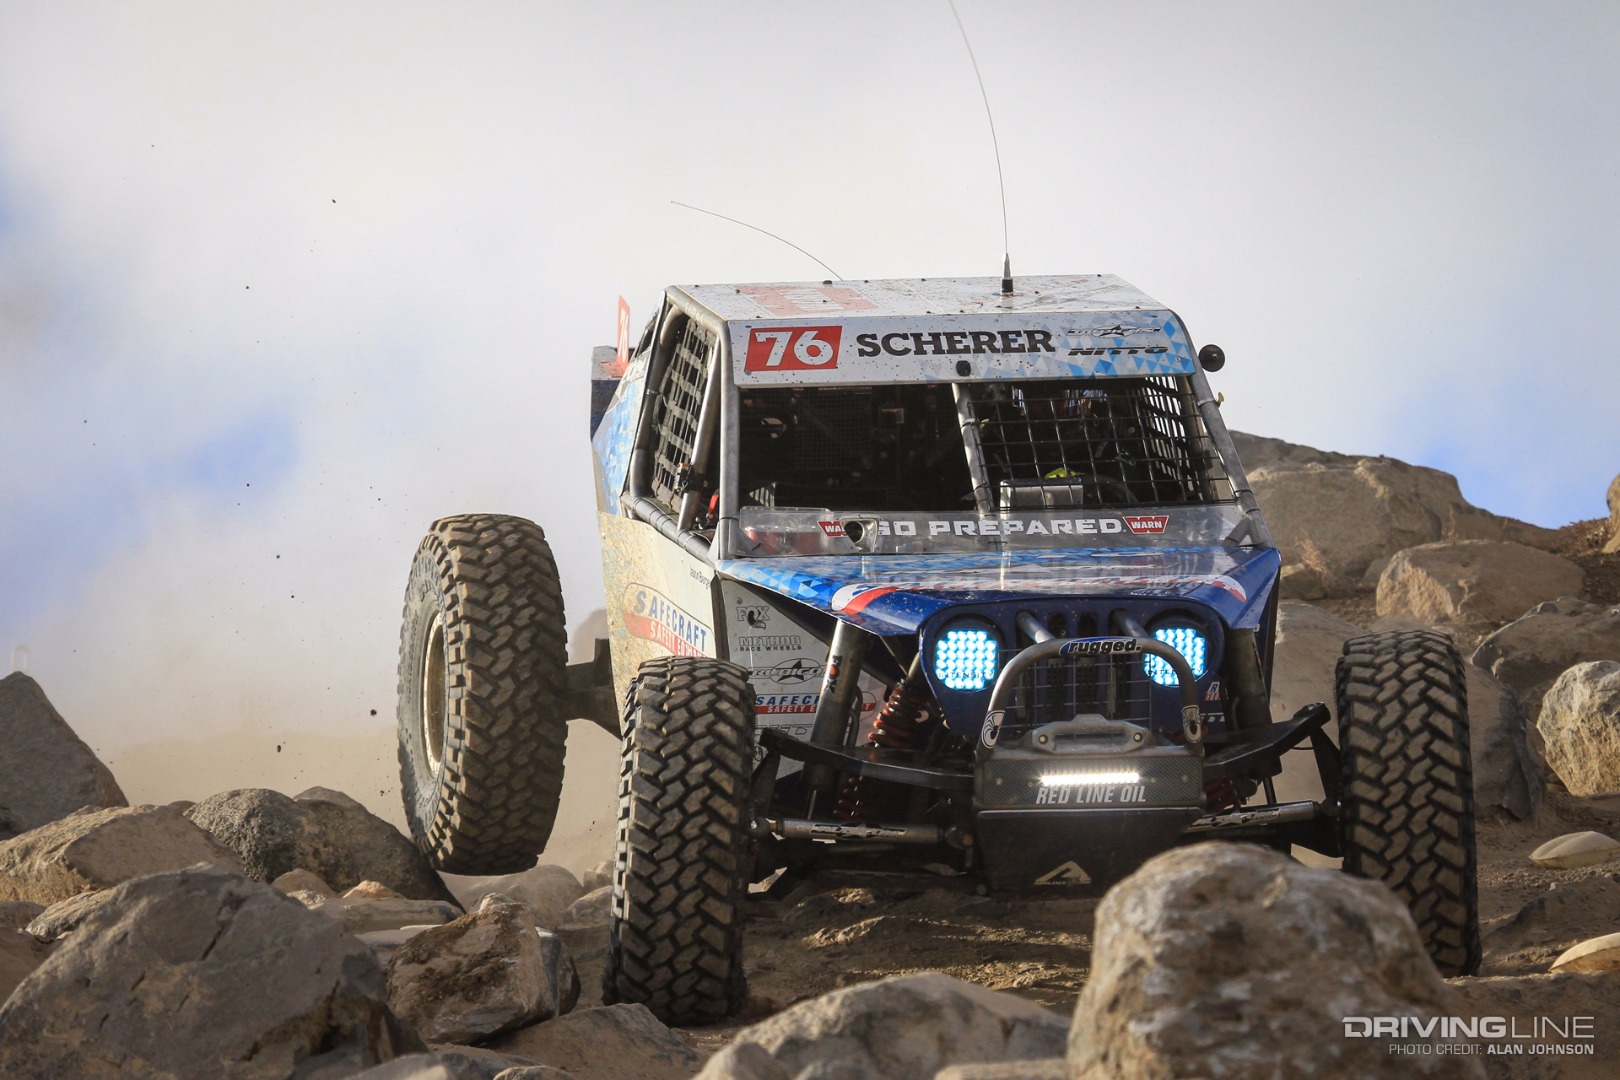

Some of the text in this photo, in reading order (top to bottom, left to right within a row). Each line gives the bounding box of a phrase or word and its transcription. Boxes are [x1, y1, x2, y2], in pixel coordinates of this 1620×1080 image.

[754, 330, 834, 367] 76
[856, 328, 1056, 358] SCHERER
[1067, 346, 1169, 356] NITTO
[1131, 519, 1163, 530] WARN
[736, 605, 771, 622] FOX
[633, 590, 707, 652] SAFECRAFT
[739, 635, 802, 647] METHOD
[938, 671, 995, 679] INTENSITY
[767, 704, 805, 714] SAFETY
[1035, 785, 1146, 805] RED LINE OIL
